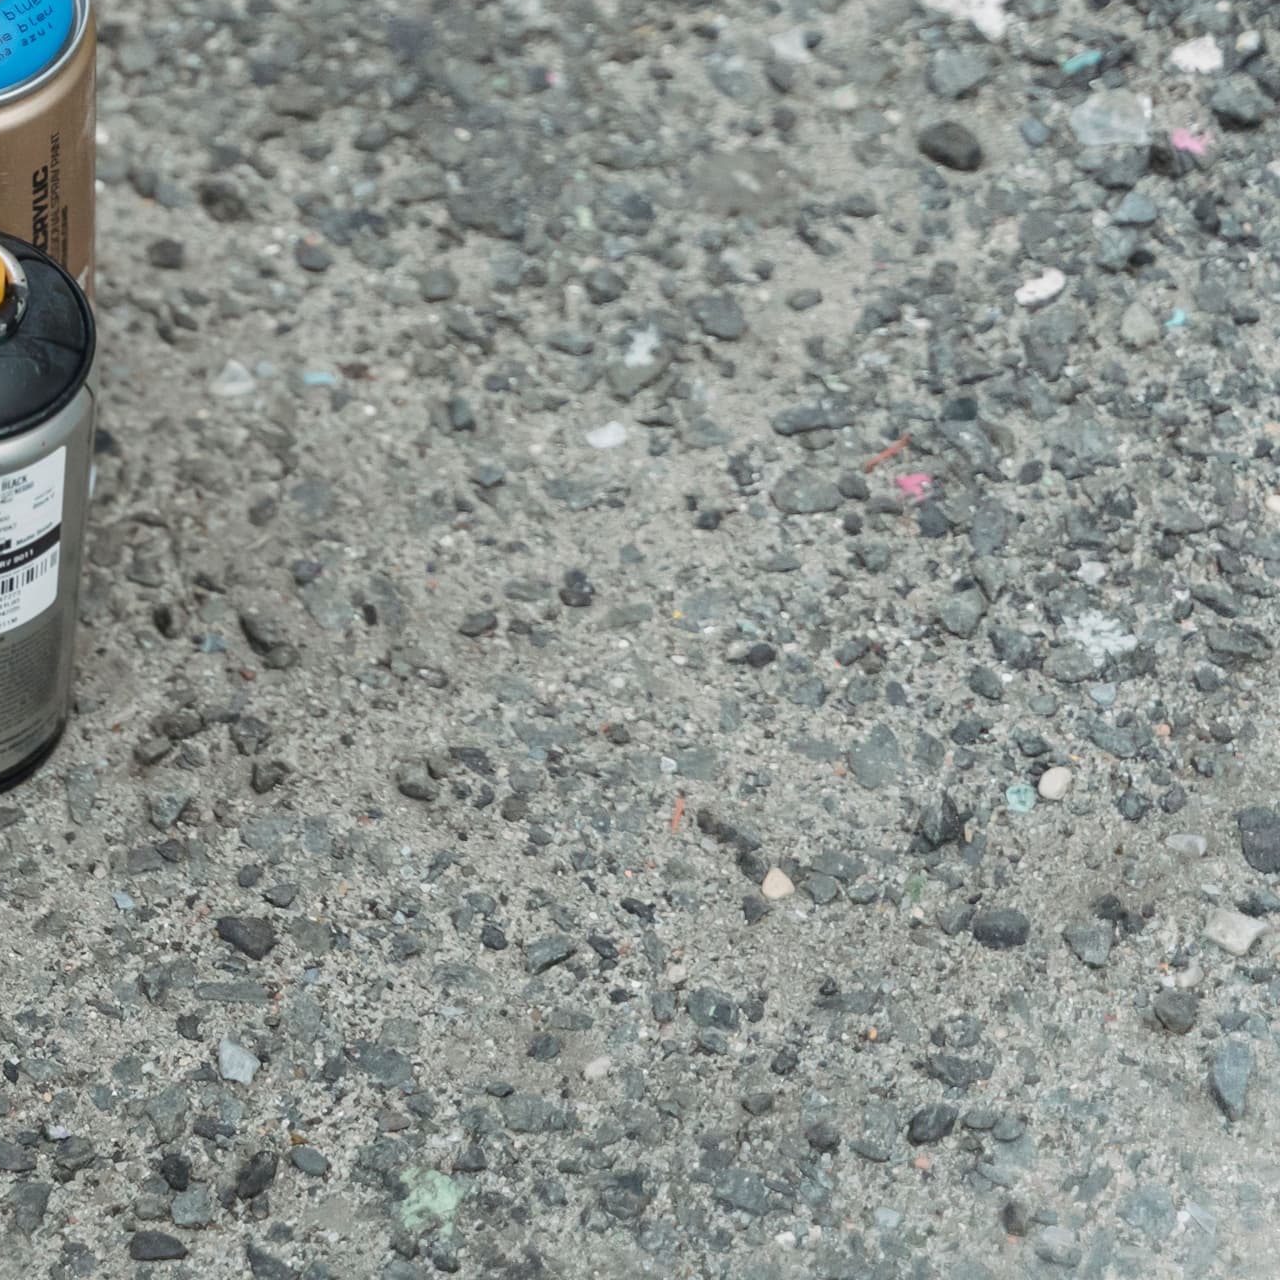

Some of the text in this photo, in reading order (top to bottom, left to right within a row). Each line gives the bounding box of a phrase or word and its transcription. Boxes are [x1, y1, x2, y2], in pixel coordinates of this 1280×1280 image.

[18, 6, 54, 33] bleu
[32, 165, 49, 251] CRYLIC
[2, 475, 28, 491] BLACK
